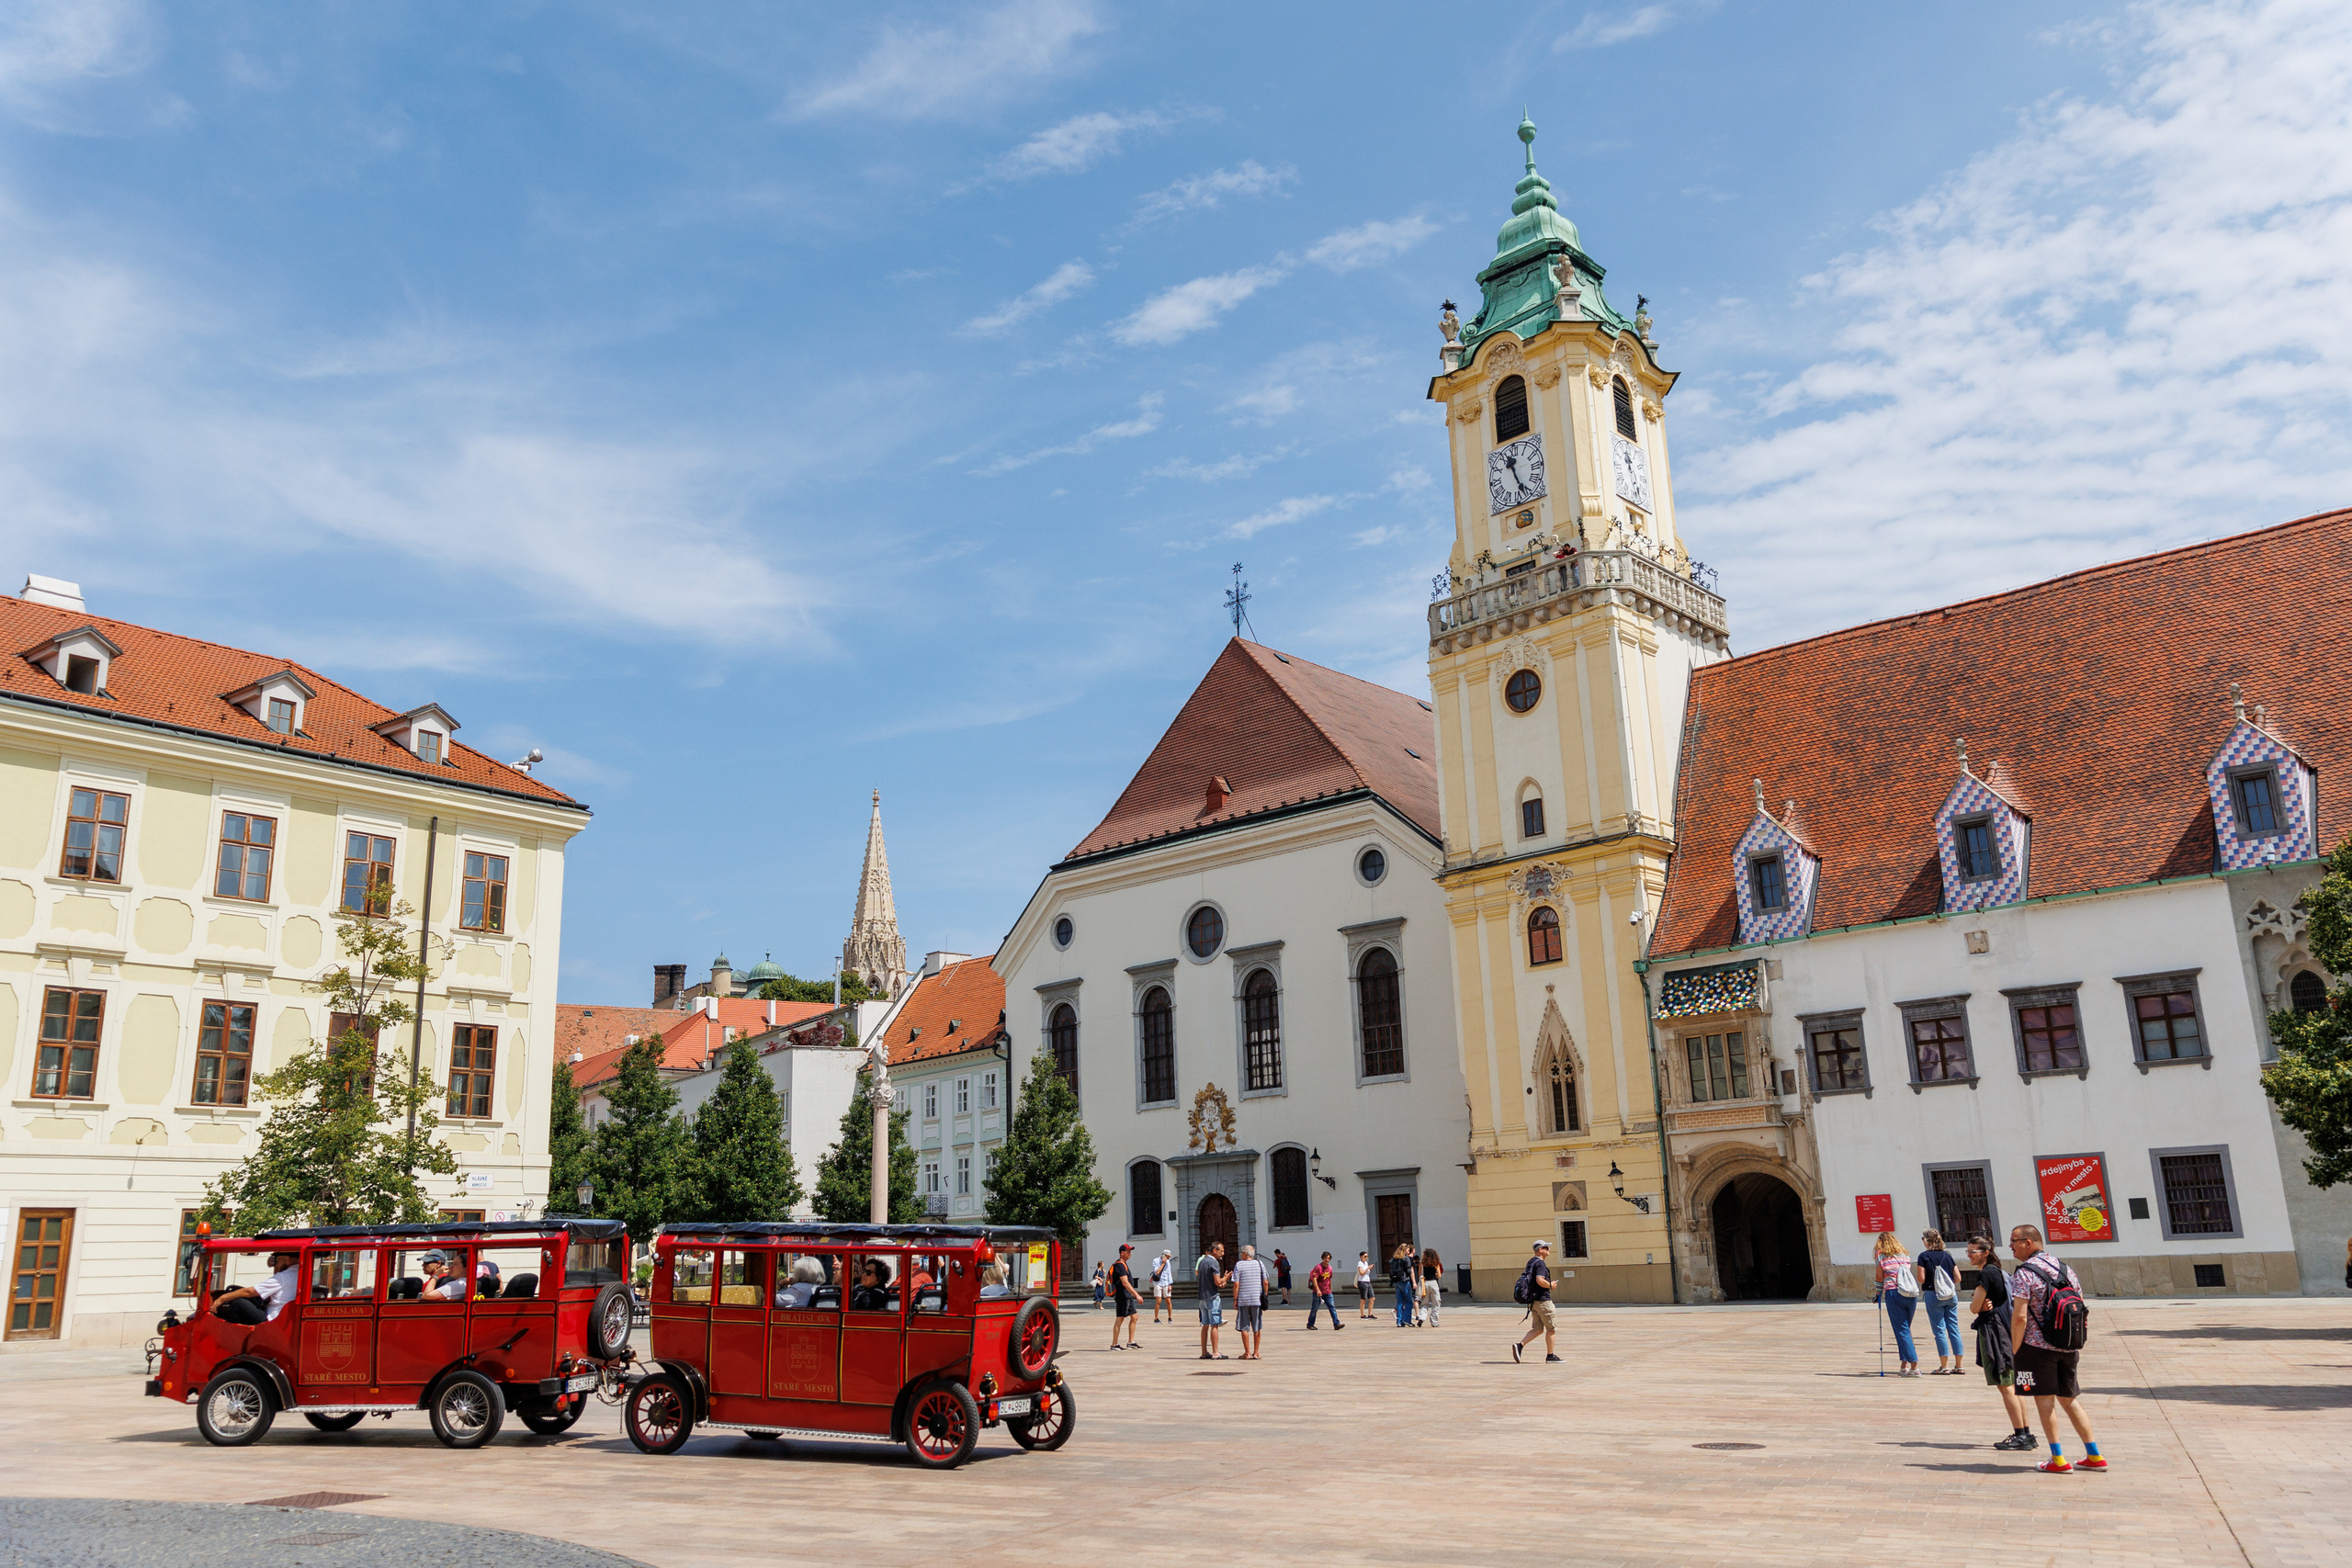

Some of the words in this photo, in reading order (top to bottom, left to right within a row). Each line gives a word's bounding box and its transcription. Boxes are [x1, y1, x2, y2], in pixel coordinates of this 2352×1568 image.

[2041, 1159, 2085, 1177] #dejinyba
[2070, 1165, 2092, 1187] mesto
[781, 1313, 830, 1322] BRATISLAVA
[978, 1321, 989, 1330] OLD
[992, 1320, 1007, 1329] TOWN
[304, 1372, 331, 1381] STARÉ
[774, 1381, 800, 1391] STARÉ
[804, 1384, 833, 1393] MESTO
